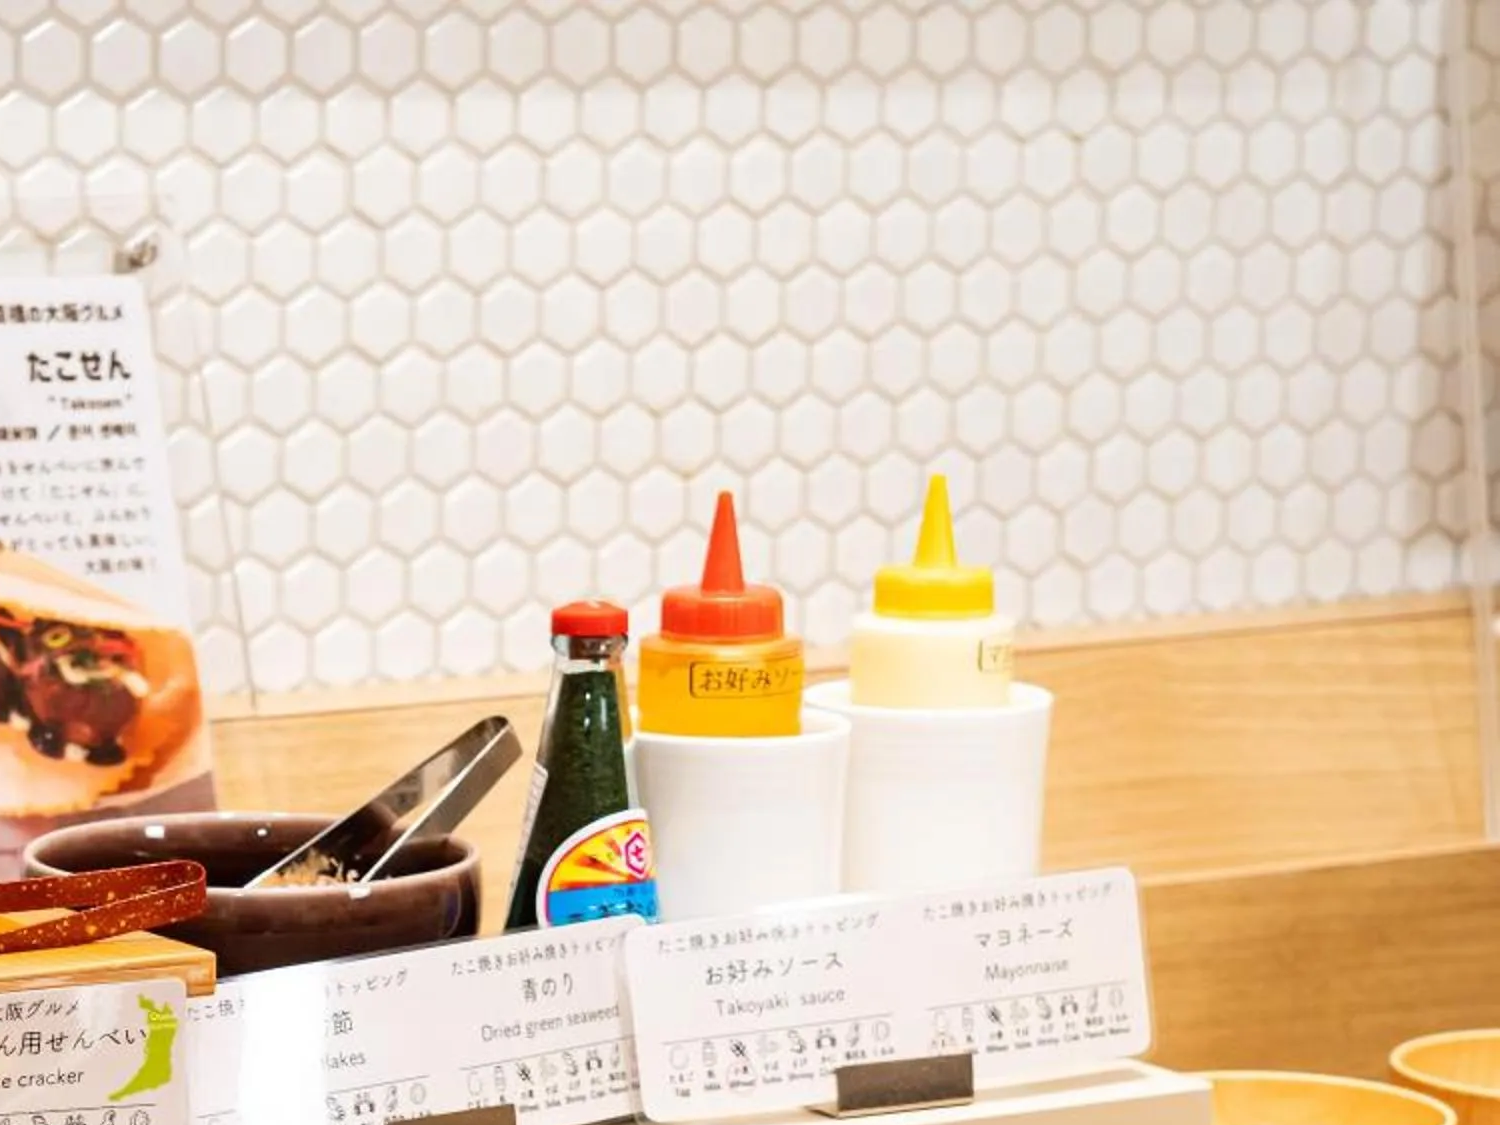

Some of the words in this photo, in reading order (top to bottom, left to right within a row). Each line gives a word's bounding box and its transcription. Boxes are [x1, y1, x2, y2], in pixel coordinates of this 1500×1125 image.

[26, 350, 131, 383] たこせん
[974, 917, 1074, 948] マヨネーズ
[705, 951, 844, 986] お好みソース
[985, 957, 1070, 983] Mayonnaise
[522, 972, 575, 1003] 青のり
[714, 992, 790, 1018] Takoyaki
[800, 988, 846, 1007] sauce
[481, 1022, 522, 1043] Dried
[525, 1017, 564, 1039] green
[566, 1004, 621, 1027] seaweed
[18, 1069, 85, 1090] cracker
